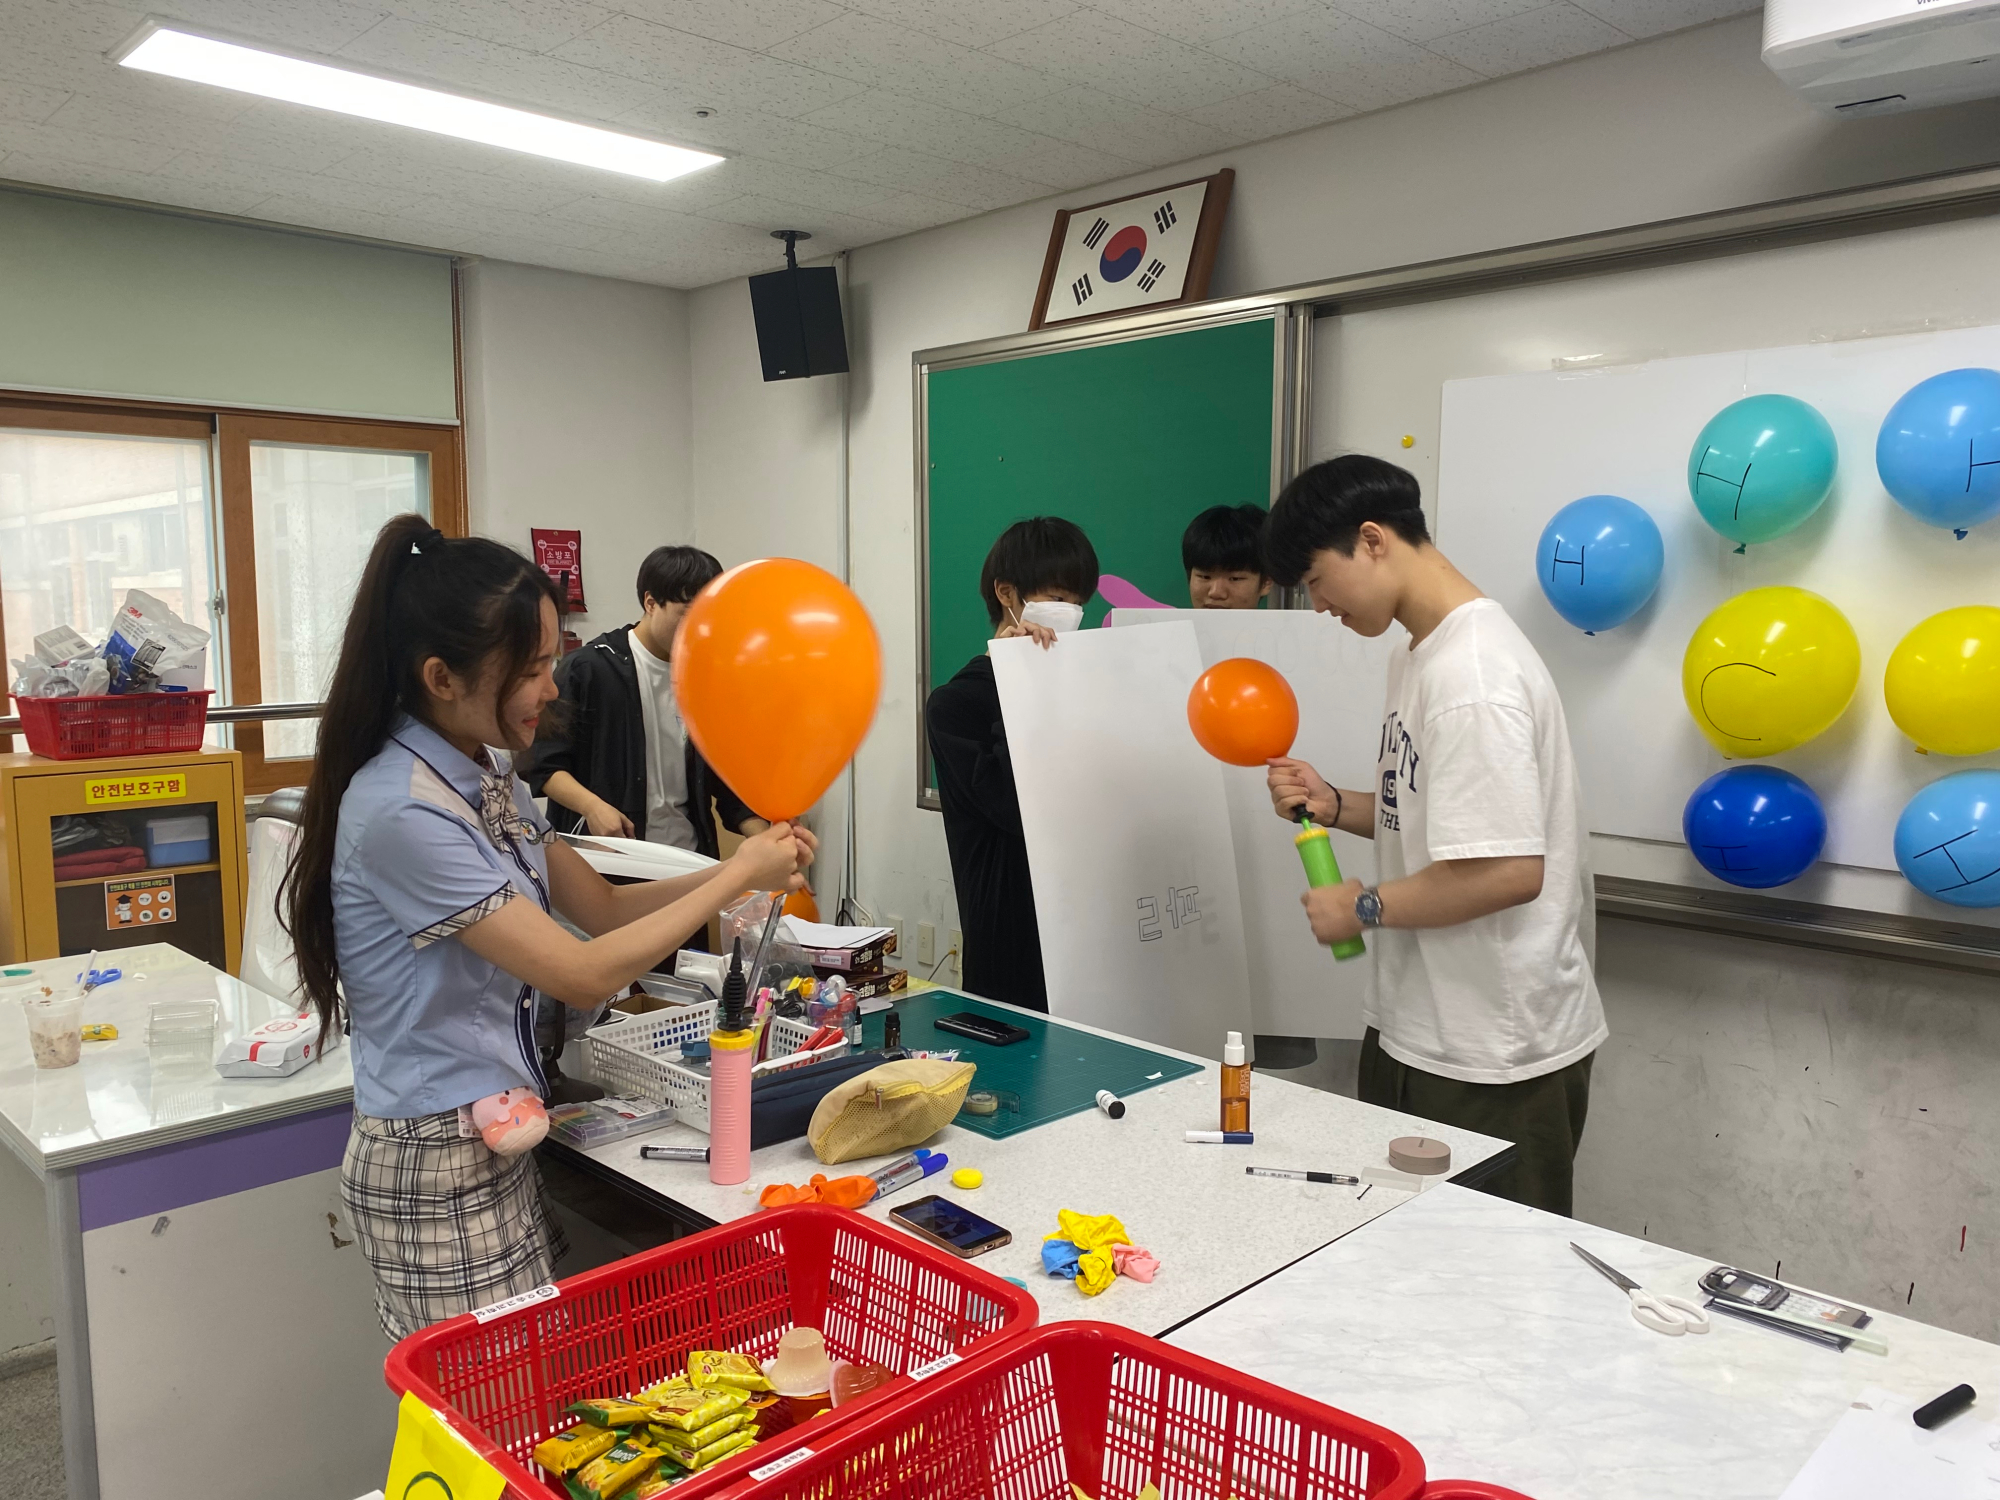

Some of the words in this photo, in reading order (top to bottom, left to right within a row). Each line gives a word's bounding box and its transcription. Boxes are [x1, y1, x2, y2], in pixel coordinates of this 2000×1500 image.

[1696, 445, 1752, 521] H
[1551, 538, 1586, 586] H
[127, 606, 143, 619] 3M
[1701, 662, 1777, 741] C
[92, 779, 180, 799] 안전보호구함
